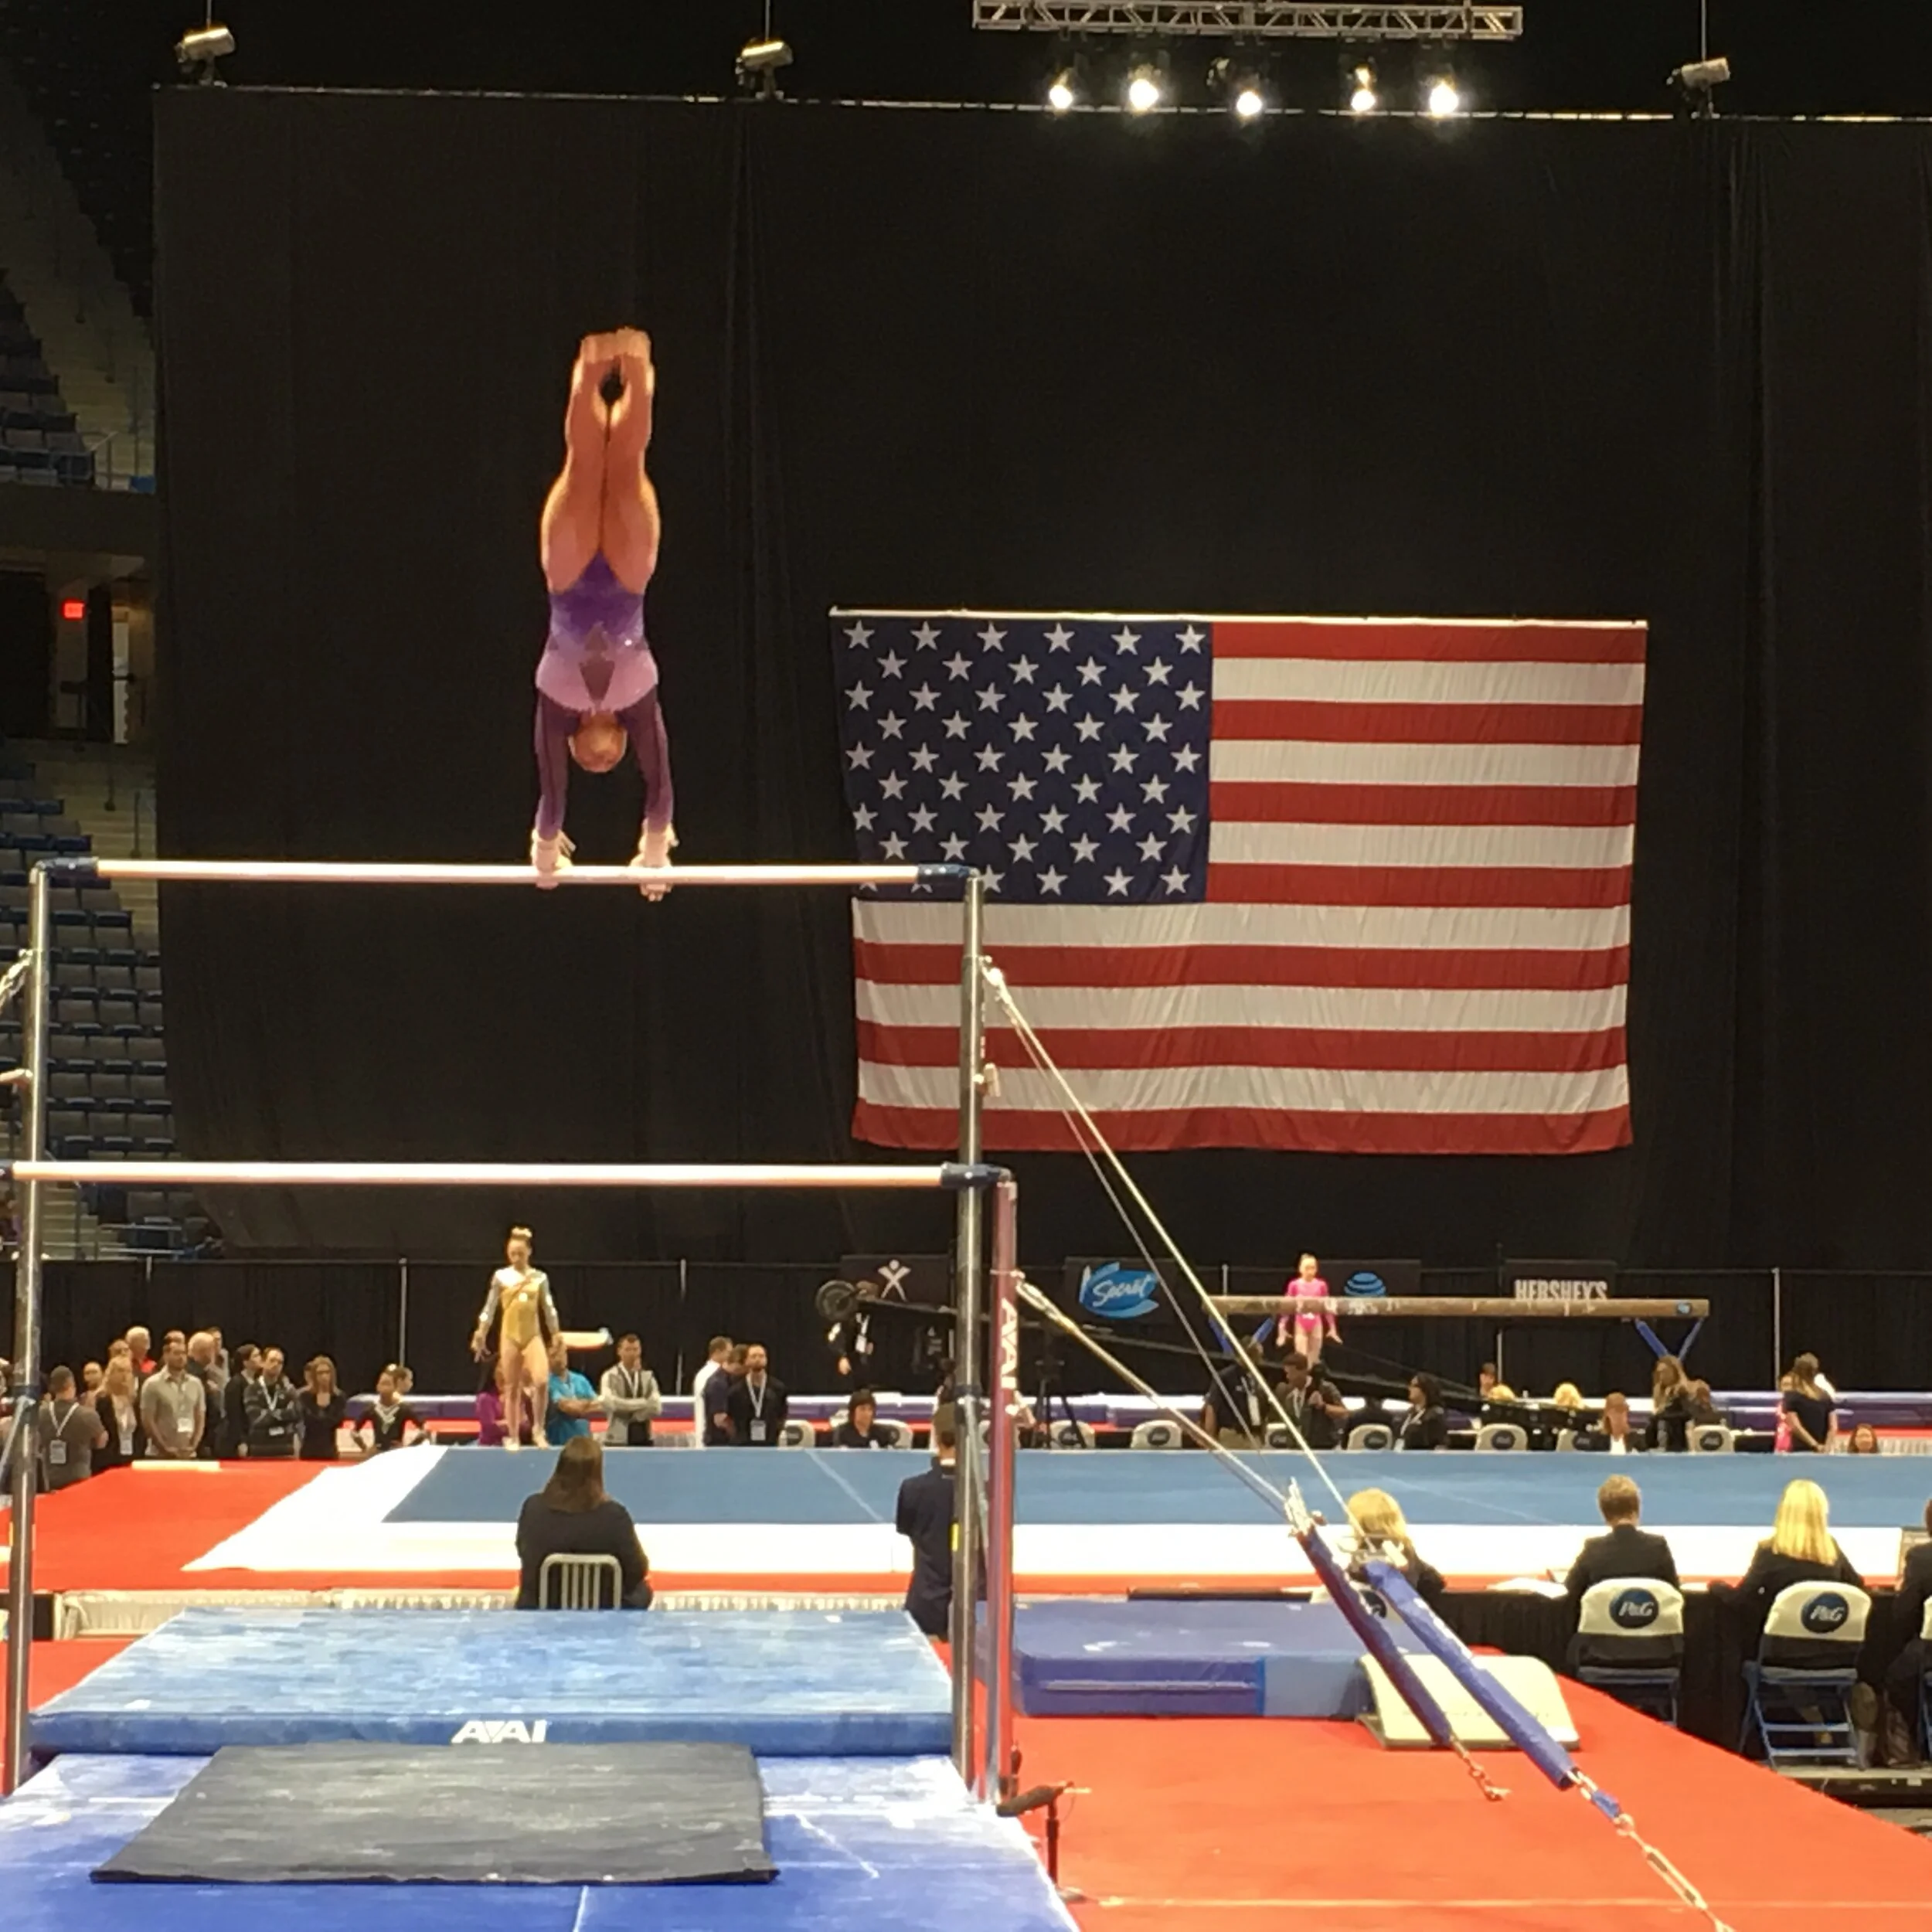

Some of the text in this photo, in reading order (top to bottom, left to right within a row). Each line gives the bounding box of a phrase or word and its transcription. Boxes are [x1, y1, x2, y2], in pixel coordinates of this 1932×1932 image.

[1092, 1274, 1151, 1308] Secret
[1618, 1601, 1654, 1617] P&G
[1810, 1604, 1845, 1621] P&G
